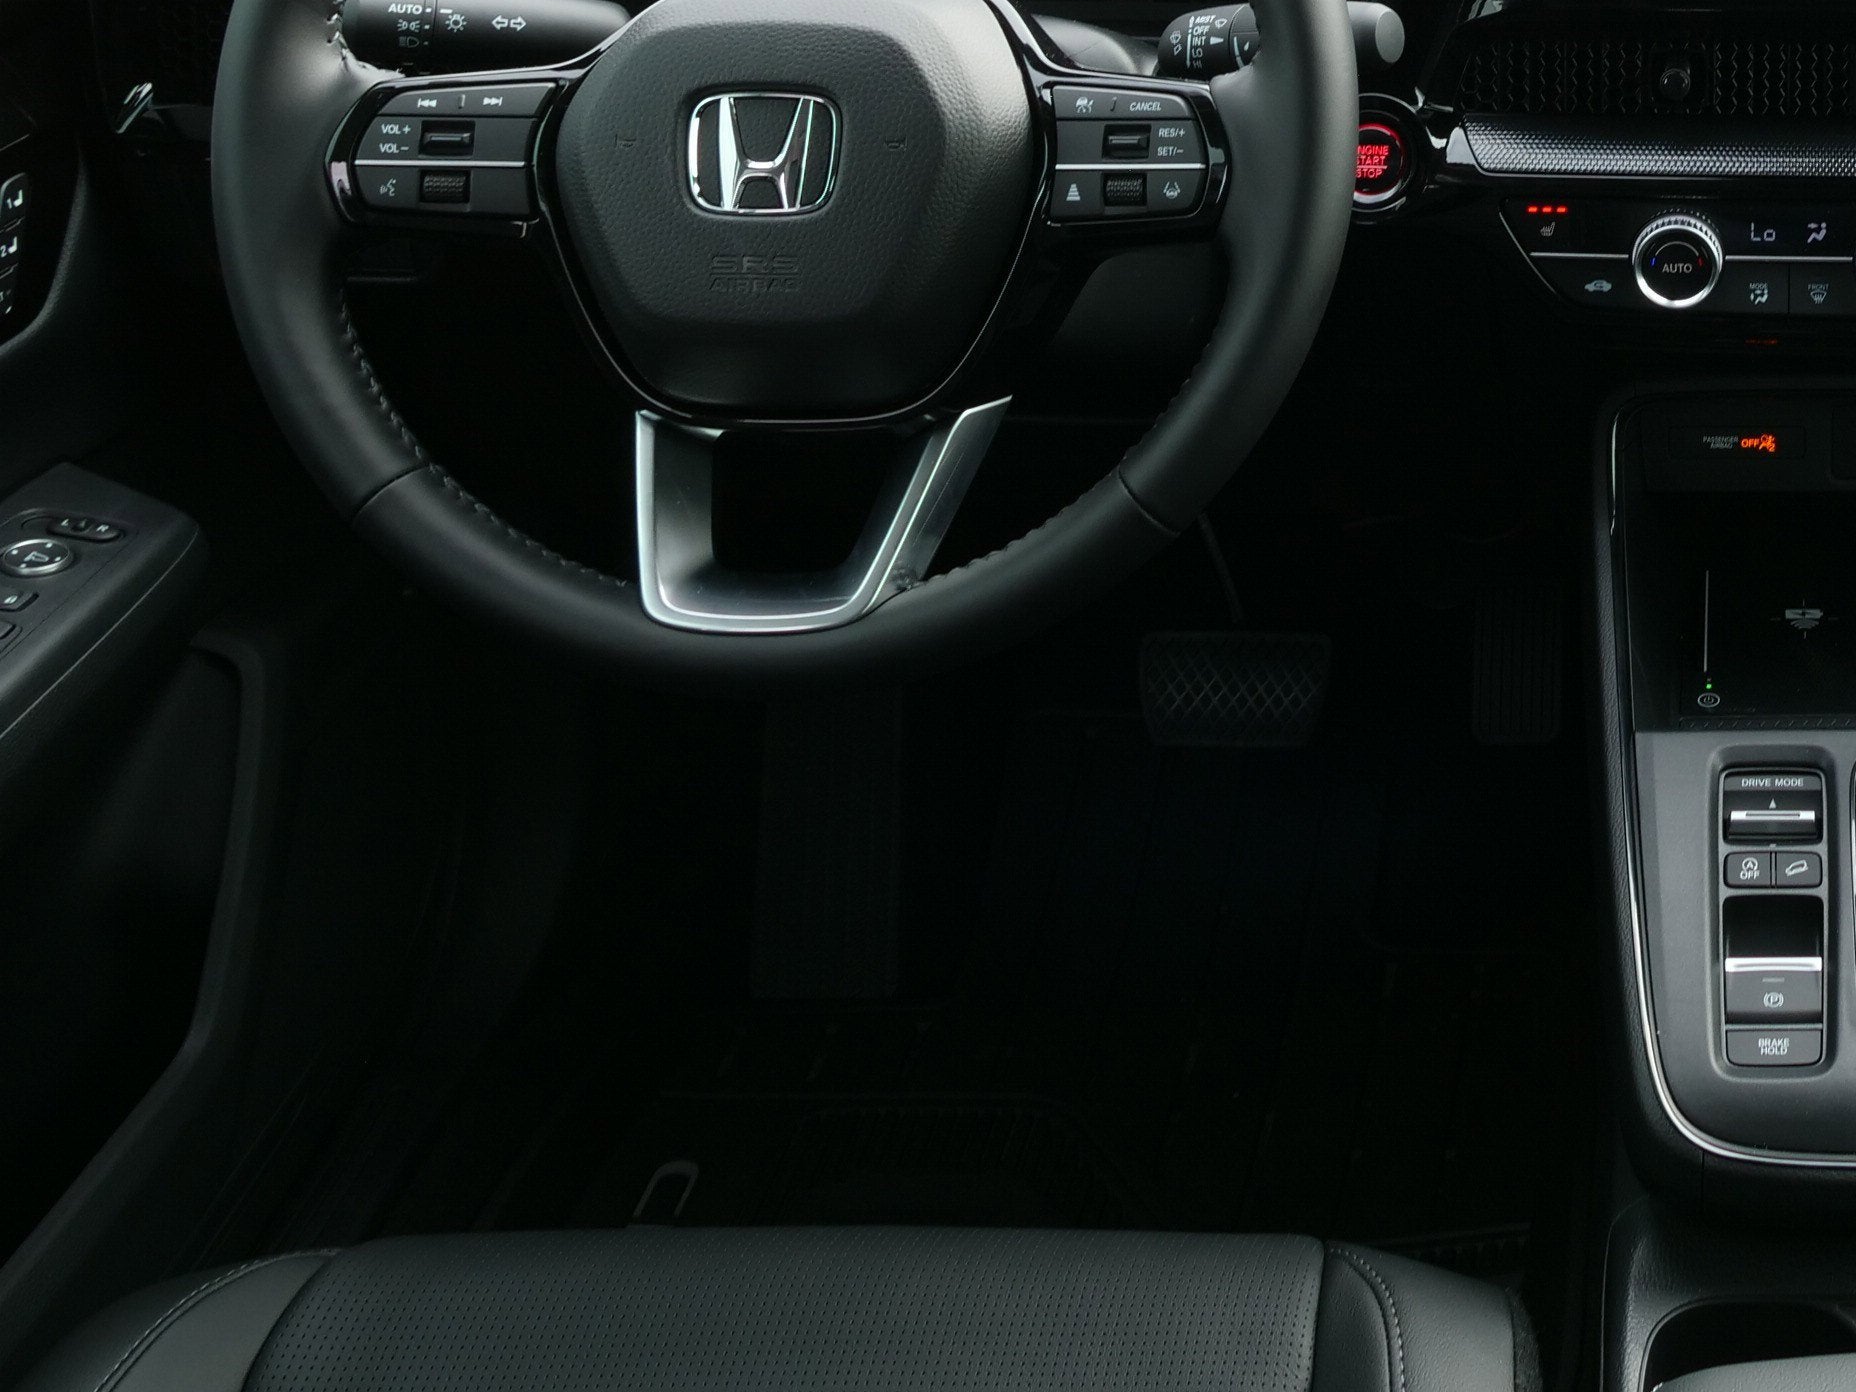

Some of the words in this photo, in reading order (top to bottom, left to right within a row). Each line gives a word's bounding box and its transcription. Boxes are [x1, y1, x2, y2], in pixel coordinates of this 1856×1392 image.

[389, 4, 422, 14] AUTO
[1193, 26, 1210, 35] OFF
[1193, 36, 1206, 46] INT
[1192, 48, 1203, 58] LO
[1130, 102, 1161, 112] CANCEL
[1357, 145, 1389, 155] NGINE
[711, 255, 800, 274] SRS
[1662, 263, 1692, 274] AUTO
[1741, 438, 1760, 449] OFF
[1741, 778, 1771, 787] DRIVE
[1774, 778, 1804, 787] MODE
[1740, 871, 1759, 879] OFF
[1758, 1038, 1790, 1048] BRAKE
[1761, 1046, 1788, 1055] HOLD
